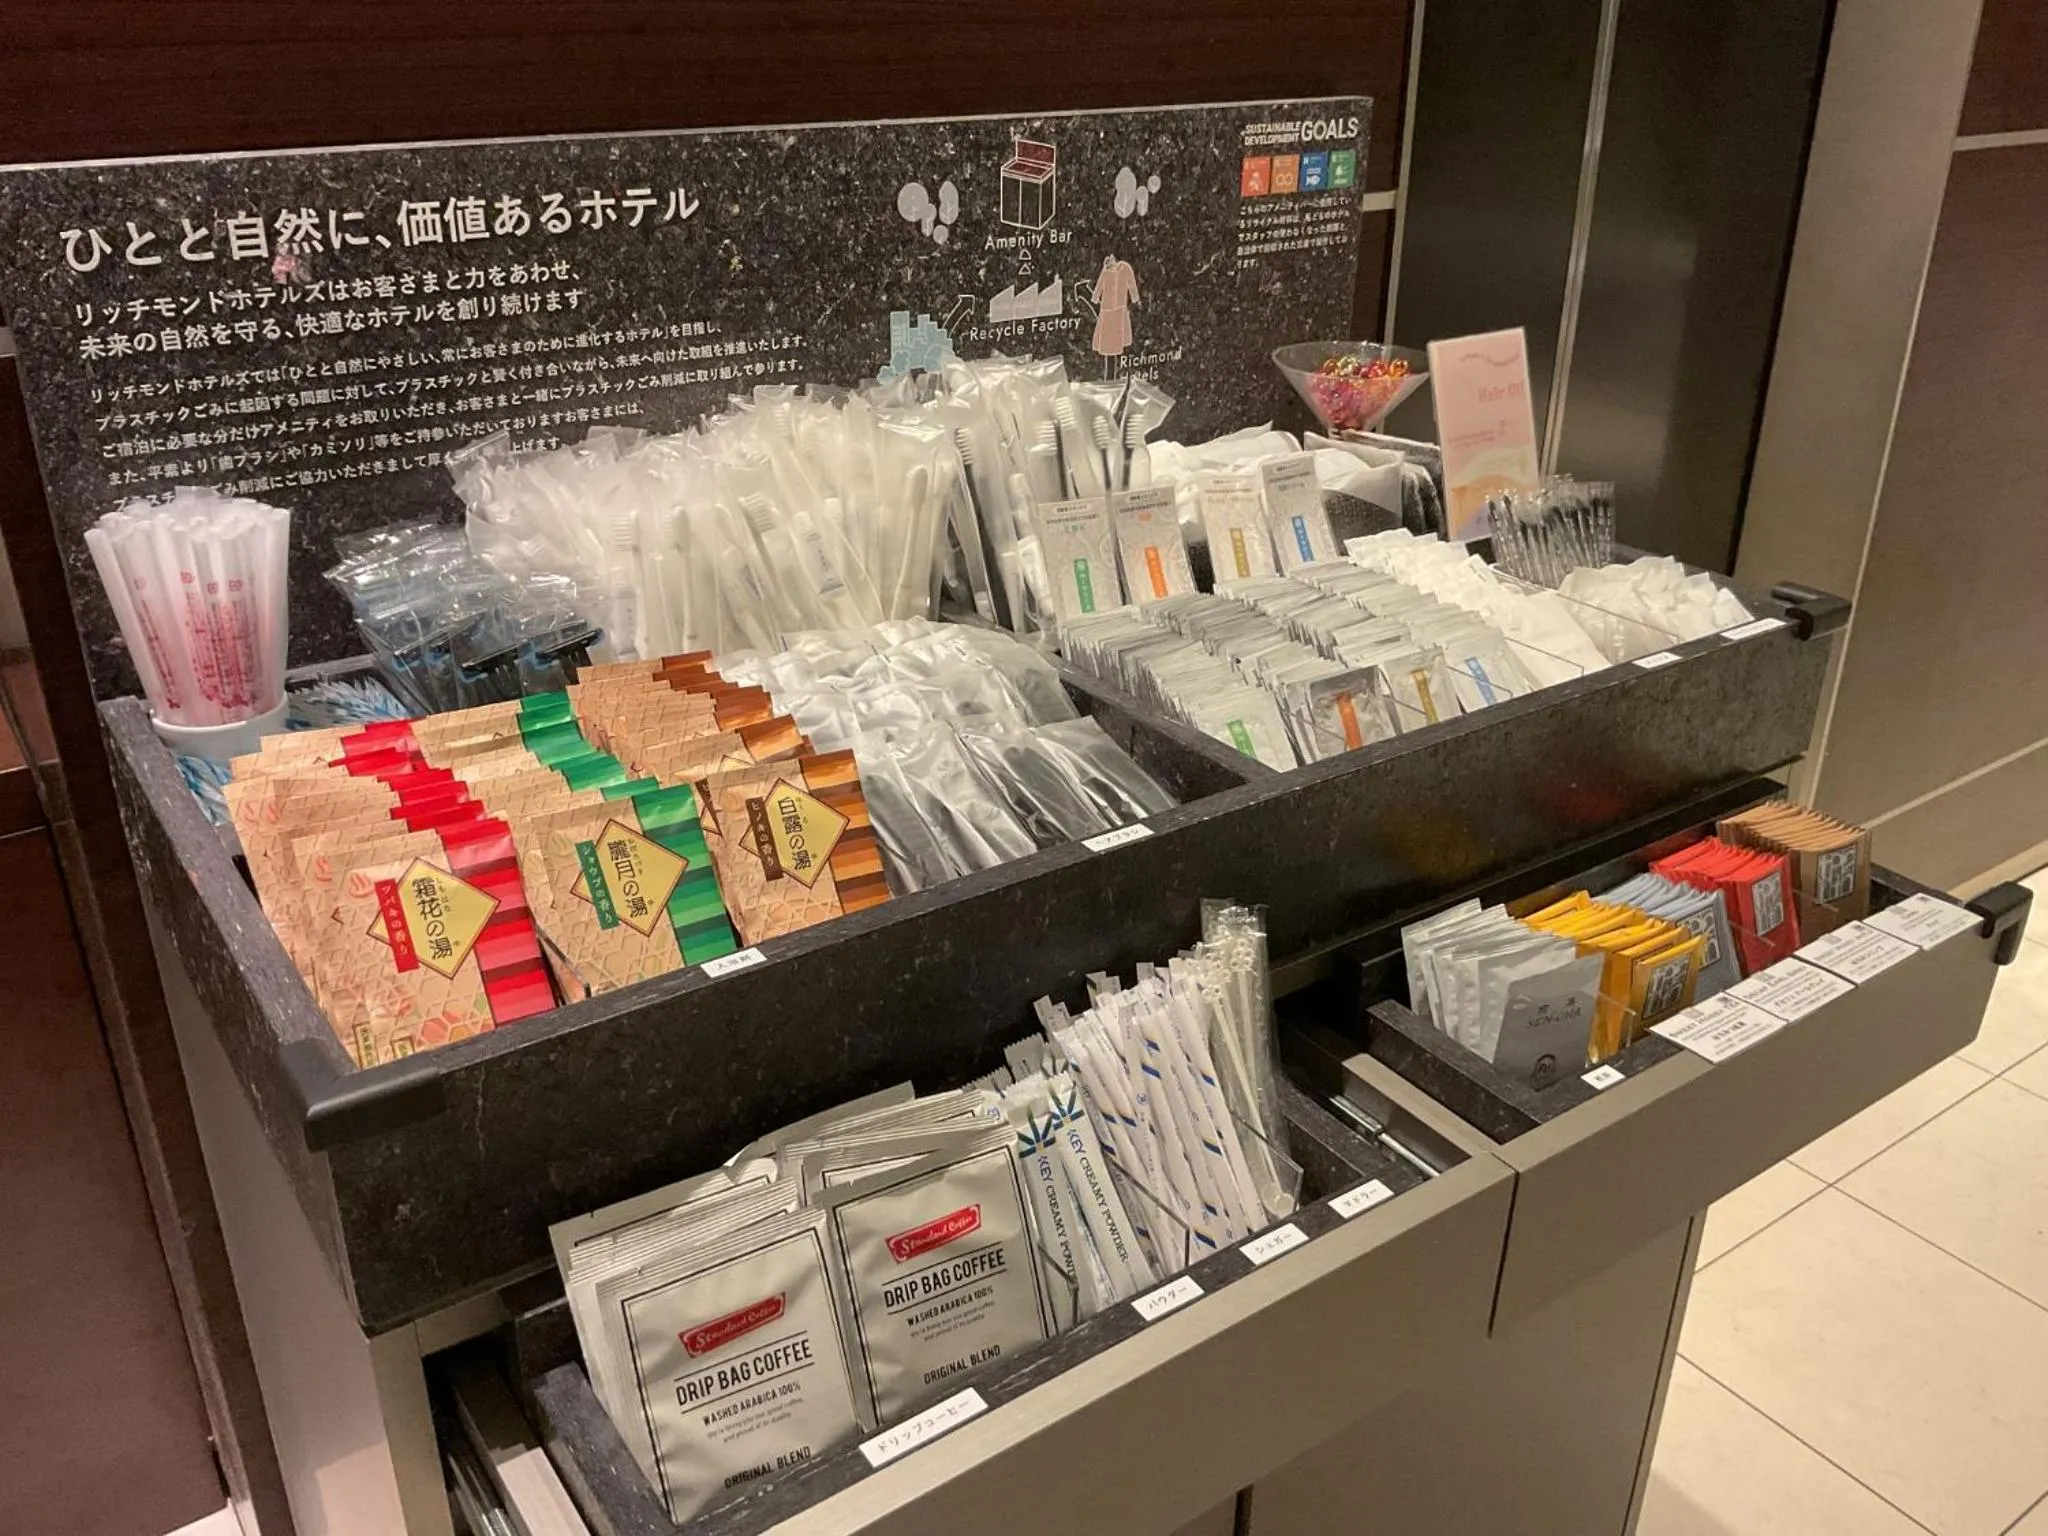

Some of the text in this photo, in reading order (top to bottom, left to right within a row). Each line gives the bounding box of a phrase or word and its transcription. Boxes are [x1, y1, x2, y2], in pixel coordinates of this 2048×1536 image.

[1244, 132, 1300, 146] DEVELOPMENT
[1245, 121, 1301, 134] SUSTAINABLE
[1301, 117, 1359, 142] GOALS
[60, 187, 700, 274] ひとと自然に、価値あるホテル
[984, 229, 1073, 250] Amenity Bar
[75, 259, 580, 328] リッチモンドホテルズはお客さまと力をあわせ、
[79, 287, 584, 362] 未来の自然を守る、快適なホテルを創り続けます
[969, 315, 1082, 342] Recycle Factory
[1120, 346, 1182, 369] Richmond
[751, 801, 775, 867] ヒノキの香り
[777, 796, 812, 870] 白露の湯
[607, 839, 648, 919] 朧月の湯
[380, 884, 409, 956] ツバキの香り
[411, 875, 454, 961] 霜花の湯
[1037, 1155, 1054, 1182] KEY
[1045, 1184, 1068, 1238] CREAMY
[1066, 1129, 1129, 1263] KEY CREAMY POWDER
[883, 1248, 1006, 1309] DRIP BAG COFFEE
[907, 1305, 939, 1327] WASHED
[939, 1293, 973, 1315] ARABICA
[675, 1338, 813, 1407] DRIP BAG COFFEE
[923, 1344, 1001, 1386] ORIGINAL BLEND
[702, 1380, 801, 1426] WASHED ARABICA 100%
[878, 1400, 970, 1453] ドリップコーヒー
[723, 1445, 812, 1489] ORIGINAL BLEND
